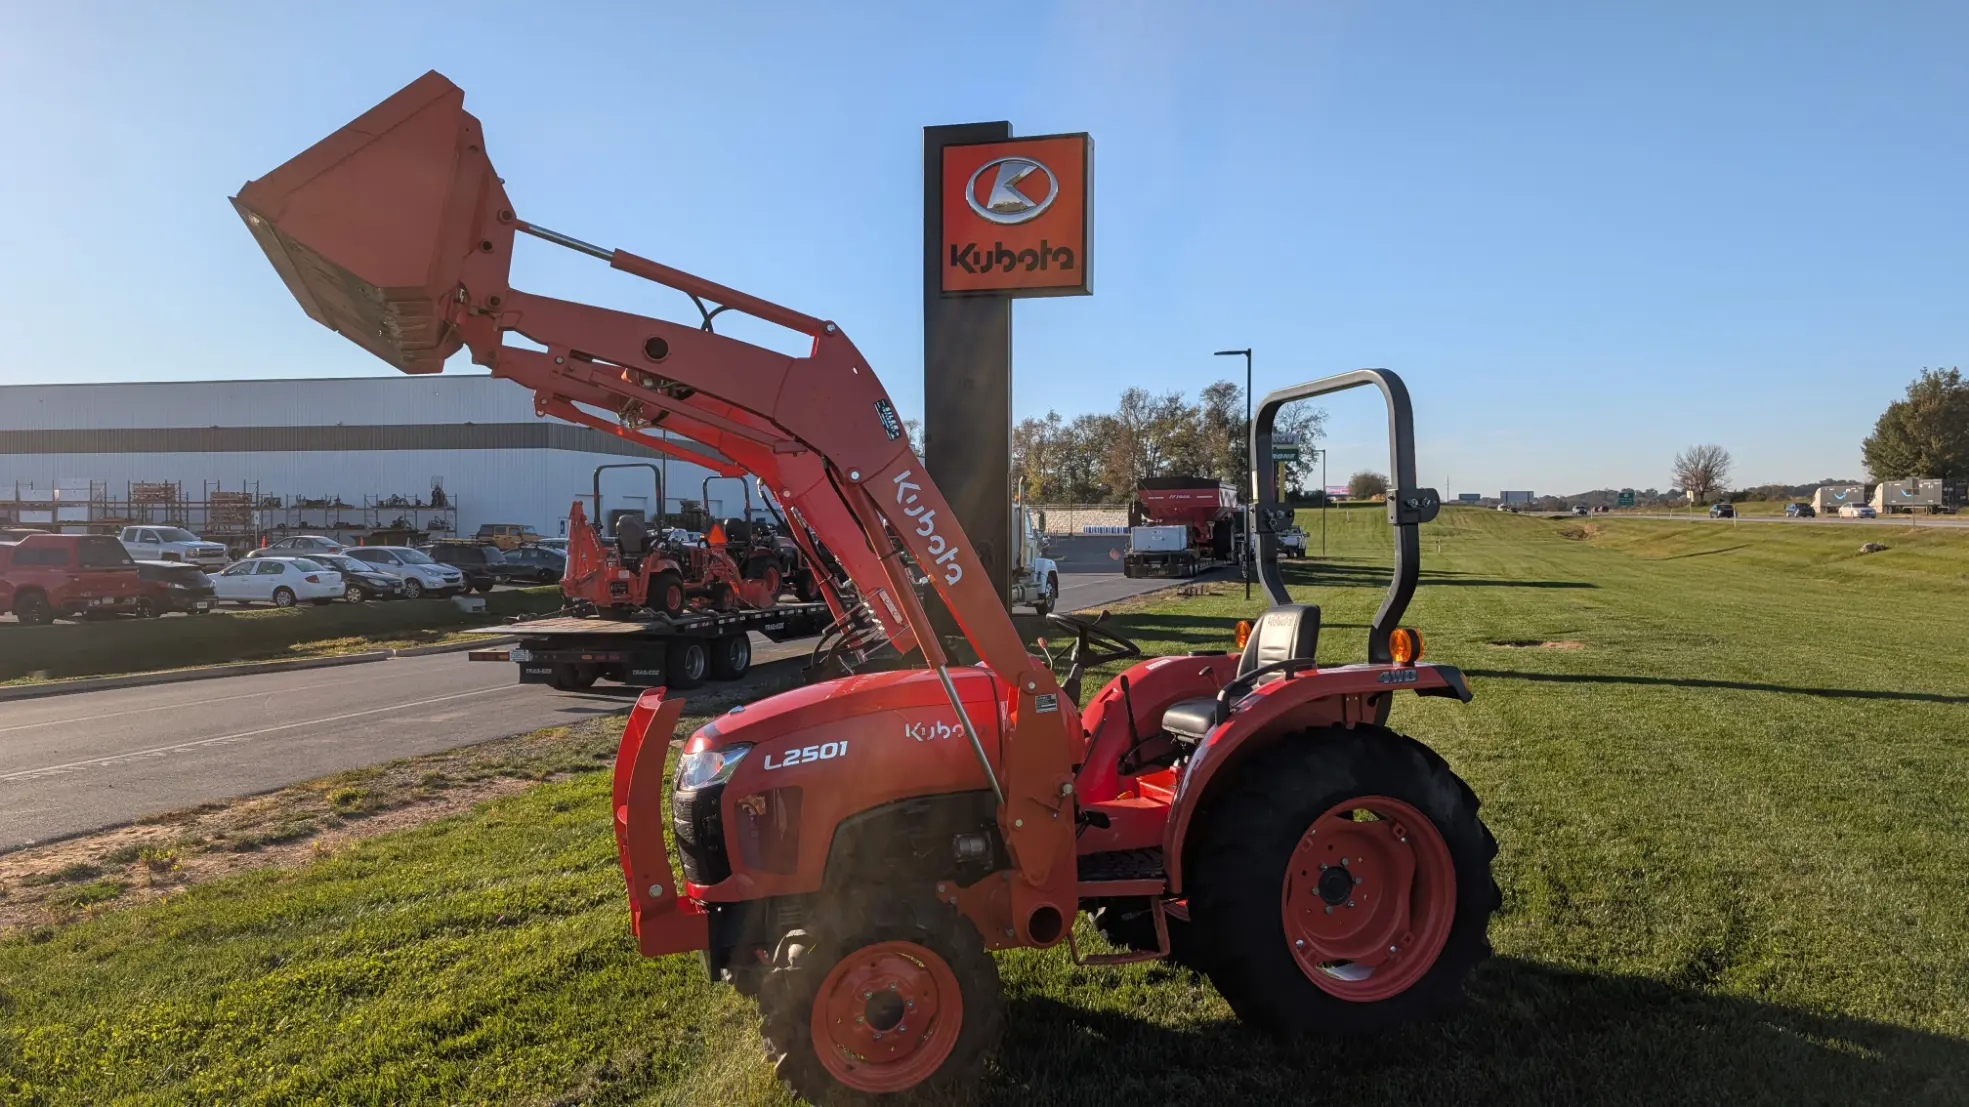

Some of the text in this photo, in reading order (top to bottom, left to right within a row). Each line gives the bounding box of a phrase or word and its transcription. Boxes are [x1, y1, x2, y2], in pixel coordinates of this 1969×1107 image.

[950, 239, 1075, 274] Kubota
[893, 469, 963, 586] Kubota
[1376, 669, 1417, 684] 4WD
[905, 720, 986, 741] Kubo
[764, 740, 848, 771] L2501
